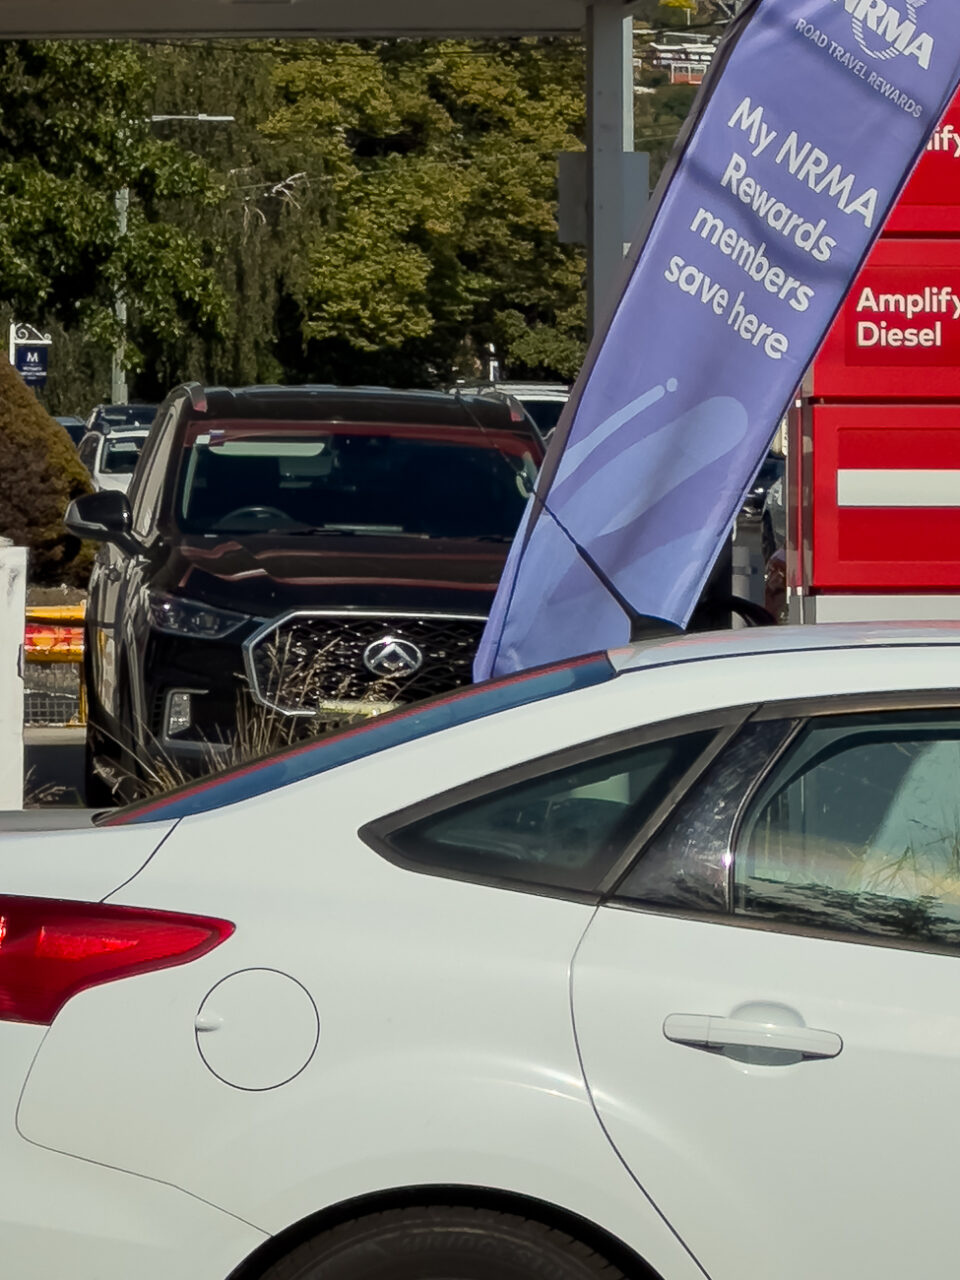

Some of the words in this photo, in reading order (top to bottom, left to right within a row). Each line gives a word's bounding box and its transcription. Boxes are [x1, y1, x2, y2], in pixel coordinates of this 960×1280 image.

[795, 18, 828, 48] ROAD
[828, 40, 868, 79] TRAVEL
[867, 72, 923, 118] REWARDS
[720, 153, 838, 263] Rewards
[728, 97, 777, 157] My
[776, 131, 879, 228] NRMA
[664, 255, 725, 316] save
[727, 291, 790, 361] here
[690, 208, 815, 312] members
[26, 352, 38, 362] M
[857, 322, 942, 347] Diesel
